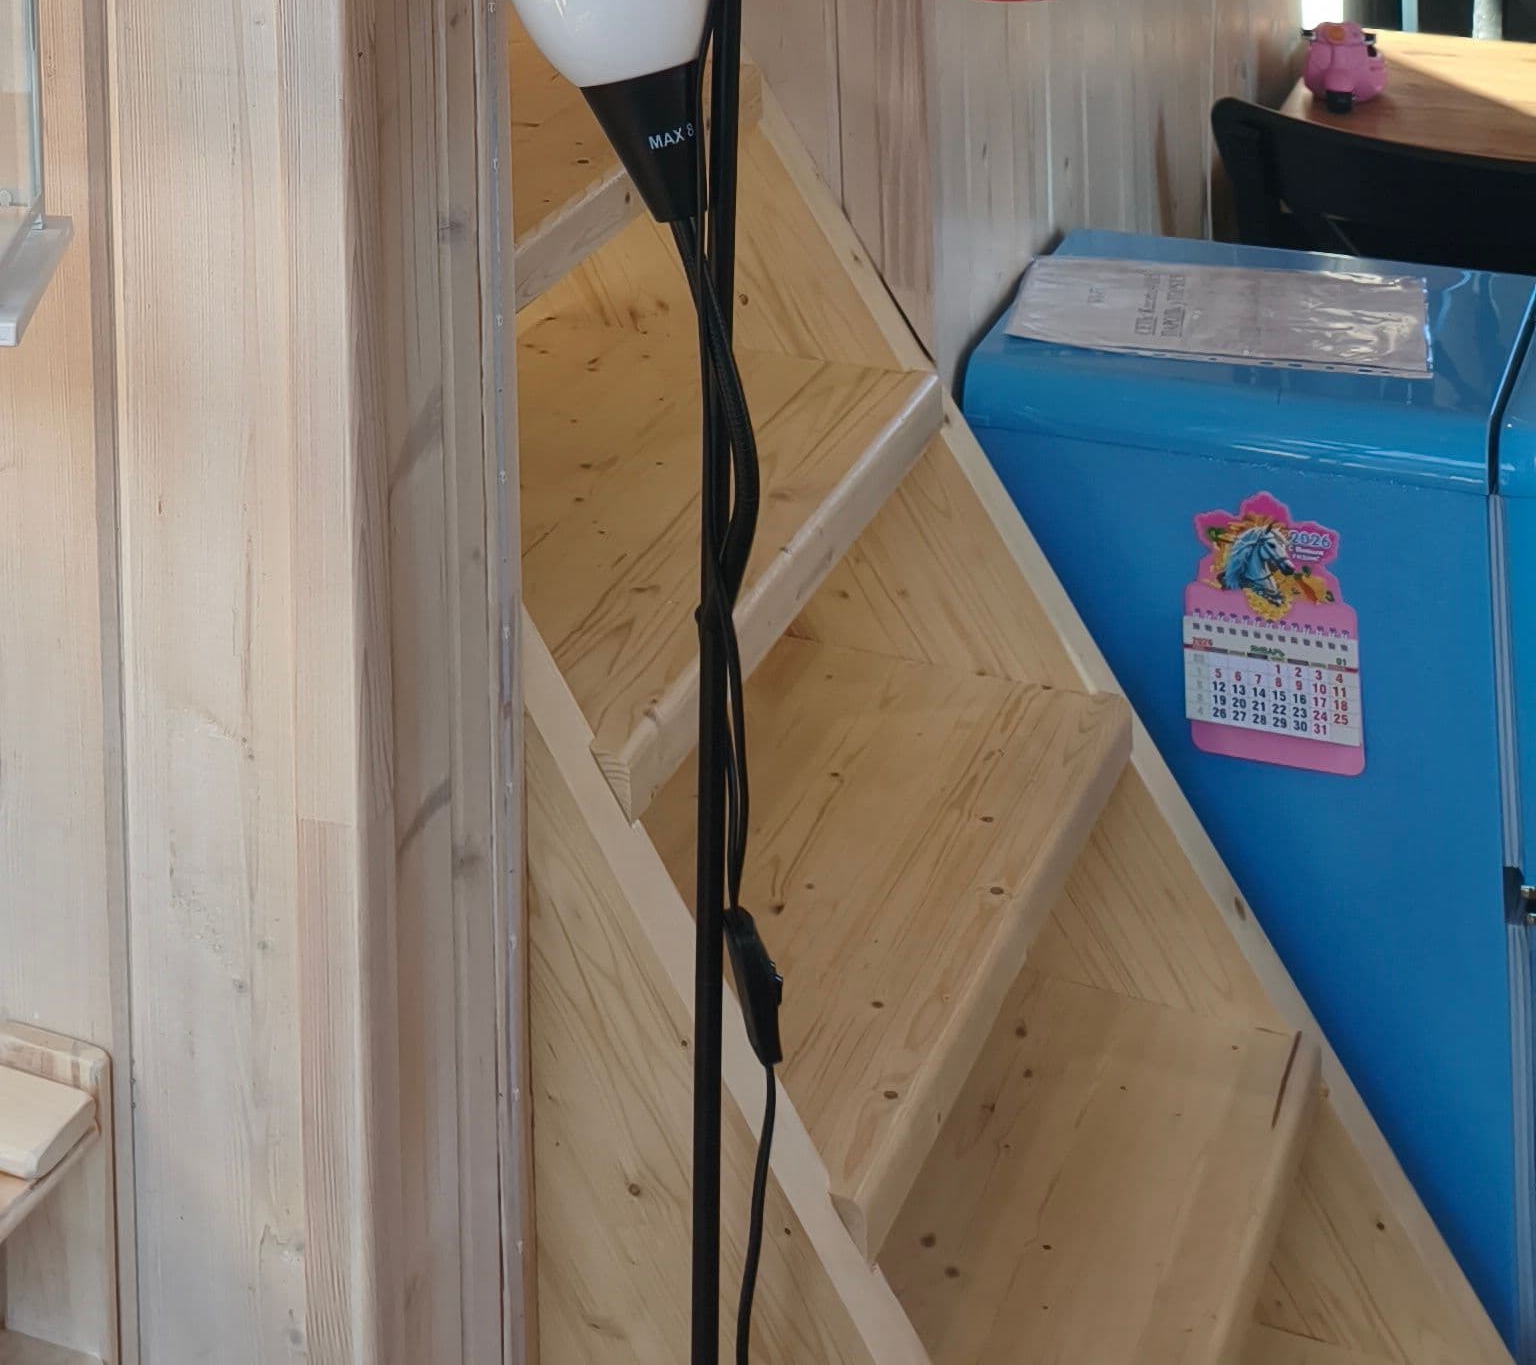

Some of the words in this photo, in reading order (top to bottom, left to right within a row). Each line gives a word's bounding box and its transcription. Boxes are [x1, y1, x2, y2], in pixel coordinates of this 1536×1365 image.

[648, 127, 685, 150] MAX
[1289, 529, 1332, 549] 2026
[1215, 668, 1222, 678] 5
[1234, 671, 1242, 681] 6
[1254, 674, 1262, 684] 7
[1275, 677, 1282, 687] 8
[1295, 680, 1303, 690] 9
[1312, 683, 1327, 694] 10
[1333, 686, 1346, 698] 11
[1275, 664, 1281, 674] 1
[1295, 667, 1302, 678] 2
[1315, 670, 1323, 681] 3
[1335, 673, 1343, 683] 4
[1212, 681, 1226, 692] 12
[1232, 684, 1246, 695] 13
[1252, 687, 1266, 698] 14
[1272, 690, 1286, 701] 15
[1292, 693, 1307, 704] 16
[1313, 697, 1327, 707] 17
[1333, 700, 1348, 711] 18
[1213, 694, 1226, 705] 19
[1232, 697, 1246, 708] 20
[1252, 700, 1265, 711] 21
[1272, 703, 1286, 715] 22
[1292, 707, 1307, 718] 23
[1313, 710, 1327, 721] 24
[1333, 713, 1348, 725] 25
[1213, 707, 1226, 718] 26
[1233, 710, 1246, 721] 27
[1252, 713, 1266, 725] 28
[1272, 717, 1287, 728] 29
[1293, 720, 1308, 732] 30
[1314, 723, 1327, 735] 31
